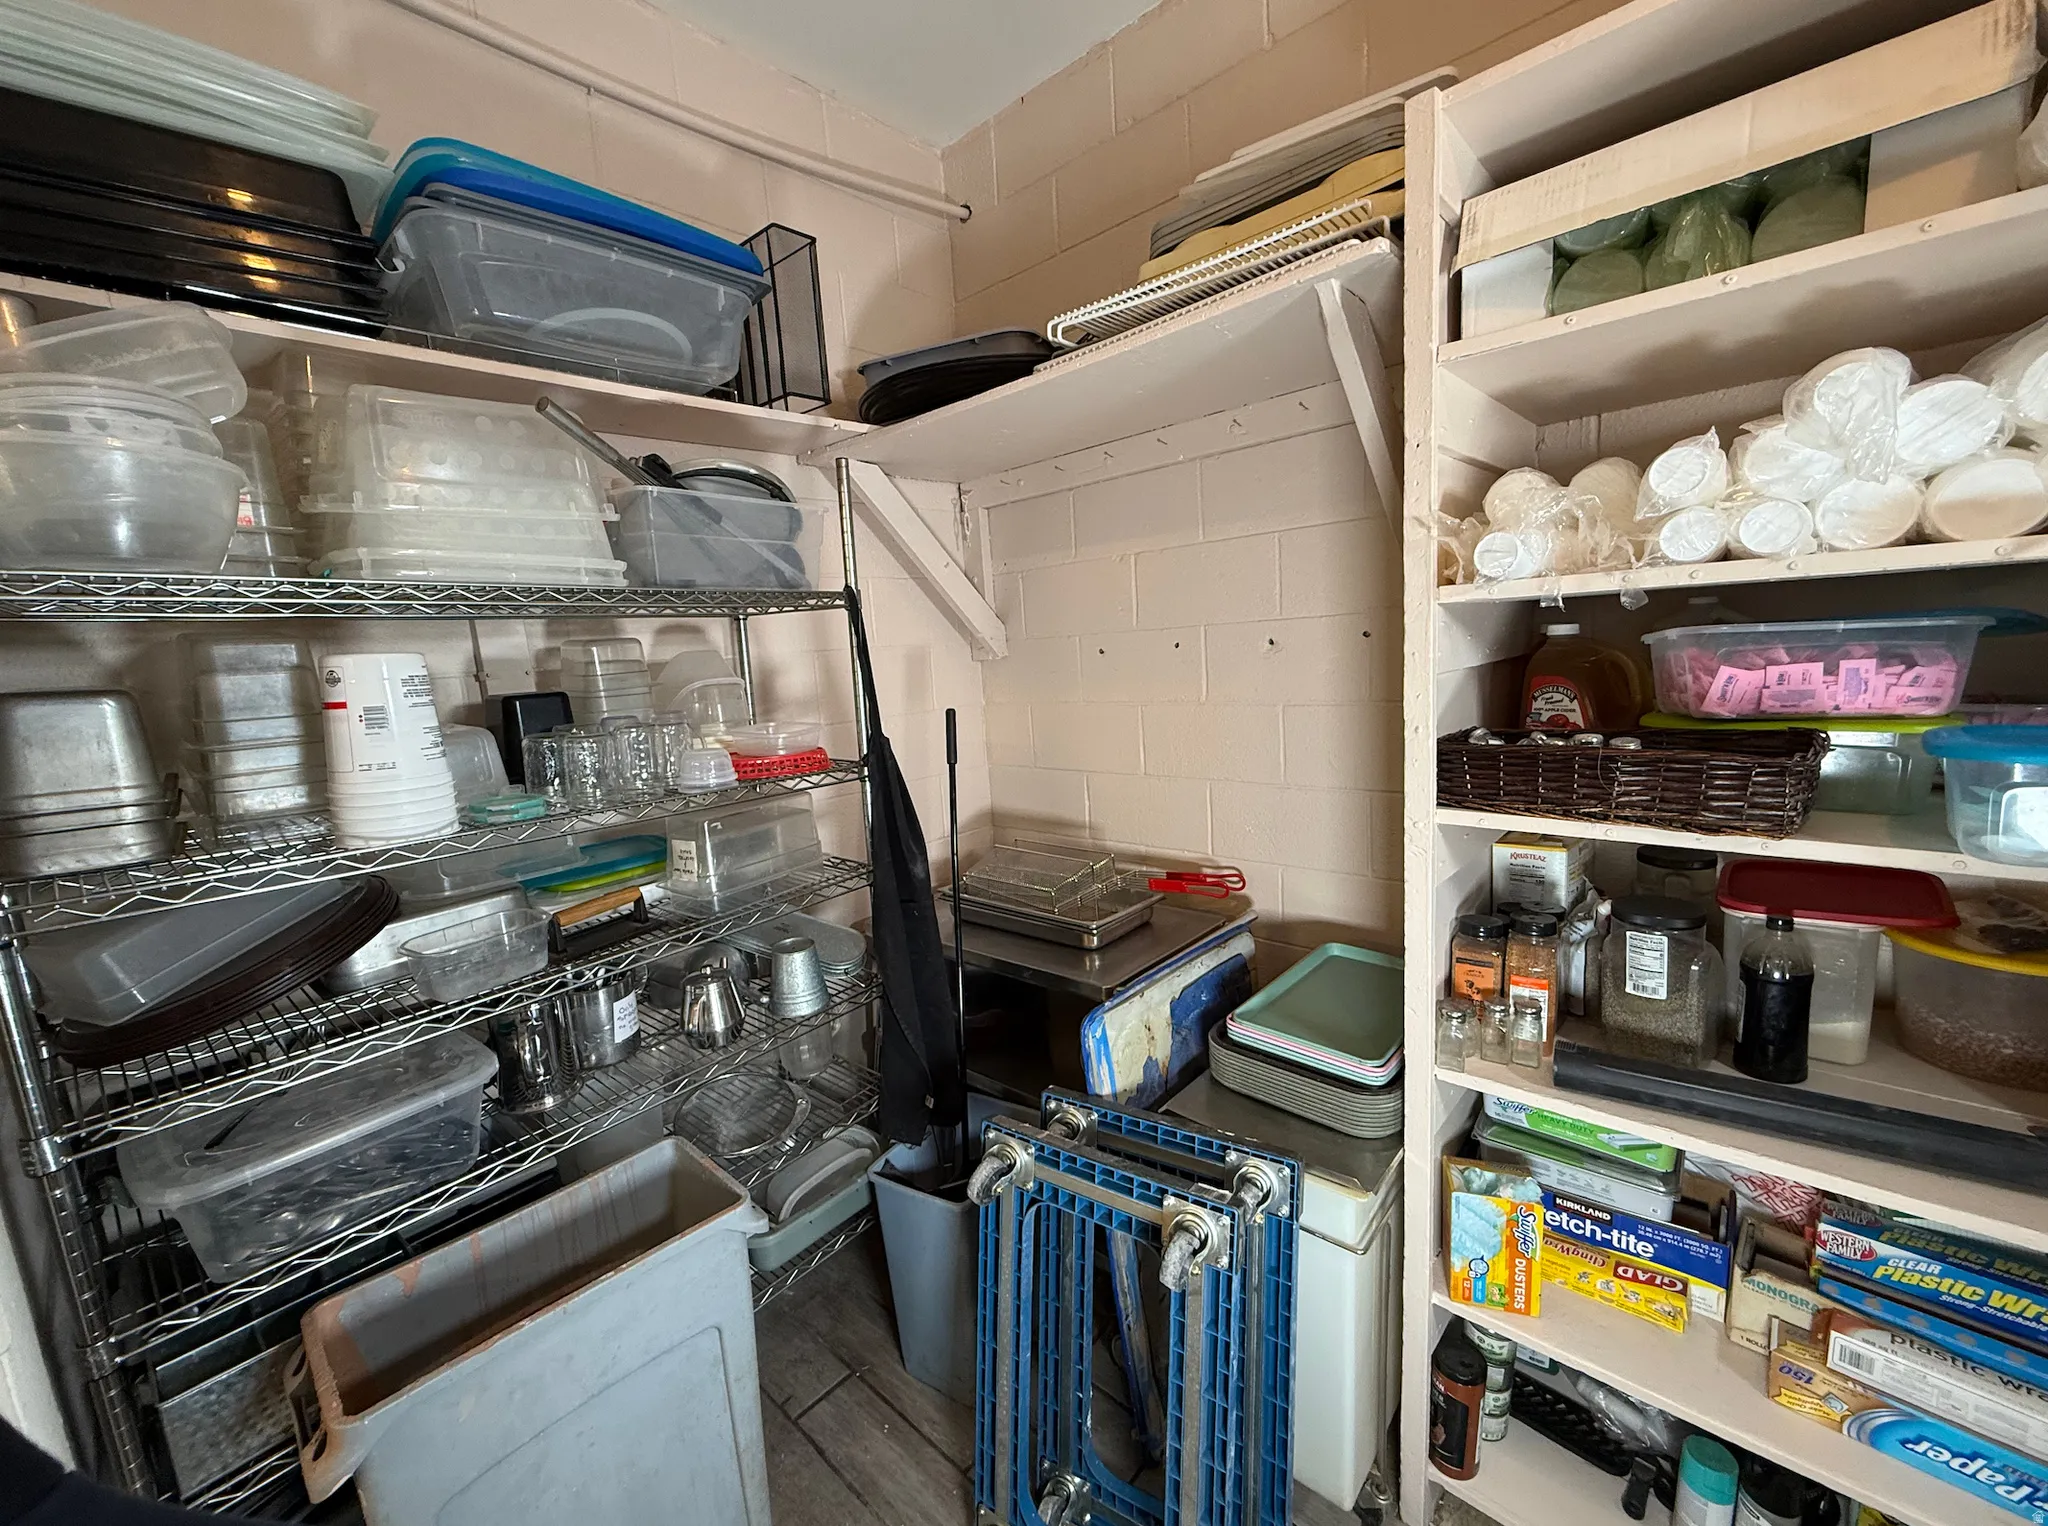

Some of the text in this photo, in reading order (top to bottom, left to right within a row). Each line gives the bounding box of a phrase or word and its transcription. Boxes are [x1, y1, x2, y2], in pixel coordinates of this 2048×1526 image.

[1509, 851, 1547, 862] KRUSTEAZ
[1493, 1096, 1536, 1115] Swiffer
[1537, 1113, 1569, 1129] HEAVY
[1570, 1121, 1595, 1134] DUTY
[1555, 1197, 1612, 1221] KIRKLAND
[1512, 1205, 1537, 1259] Swiffer
[1543, 1208, 1656, 1258] etch-tite
[1819, 1229, 1871, 1252] WESTERN
[1826, 1241, 1862, 1260] FAMILY
[1879, 1230, 1988, 1265] Plastic
[1616, 1265, 1685, 1292] GLAD
[1886, 1257, 1943, 1275] CLEAR
[1513, 1257, 1527, 1310] DUSTERS
[1872, 1264, 1986, 1301] Plastic
[1890, 1332, 1986, 1378] plastic
[1778, 1364, 1814, 1386] 150
[1904, 1440, 2034, 1502] Paper
